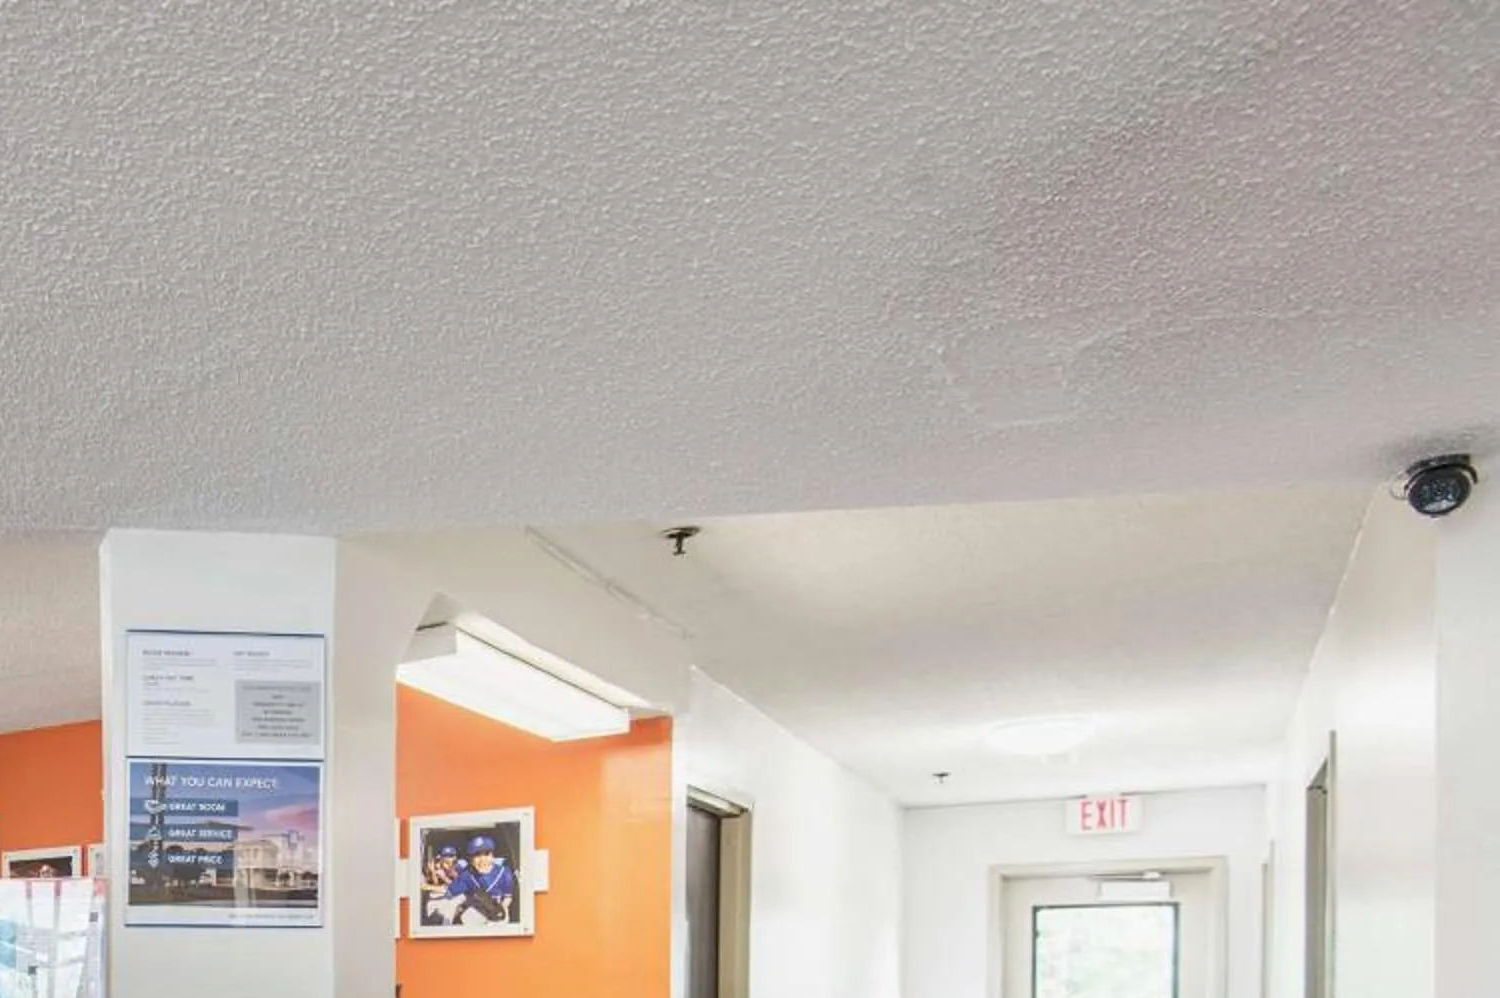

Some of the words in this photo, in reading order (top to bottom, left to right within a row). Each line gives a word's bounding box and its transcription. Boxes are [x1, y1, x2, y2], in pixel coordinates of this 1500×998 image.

[145, 775, 177, 786] WHAT
[181, 776, 205, 788] YOU
[208, 777, 233, 788] CAN
[235, 777, 279, 790] EXPECT
[169, 803, 196, 811] GREAT
[199, 803, 225, 812] ROOM
[1080, 798, 1130, 831] EXIT
[168, 829, 196, 837] GREAT
[199, 829, 232, 838] SERVICE
[168, 855, 196, 863] GREAT
[198, 855, 222, 864] PRICE
